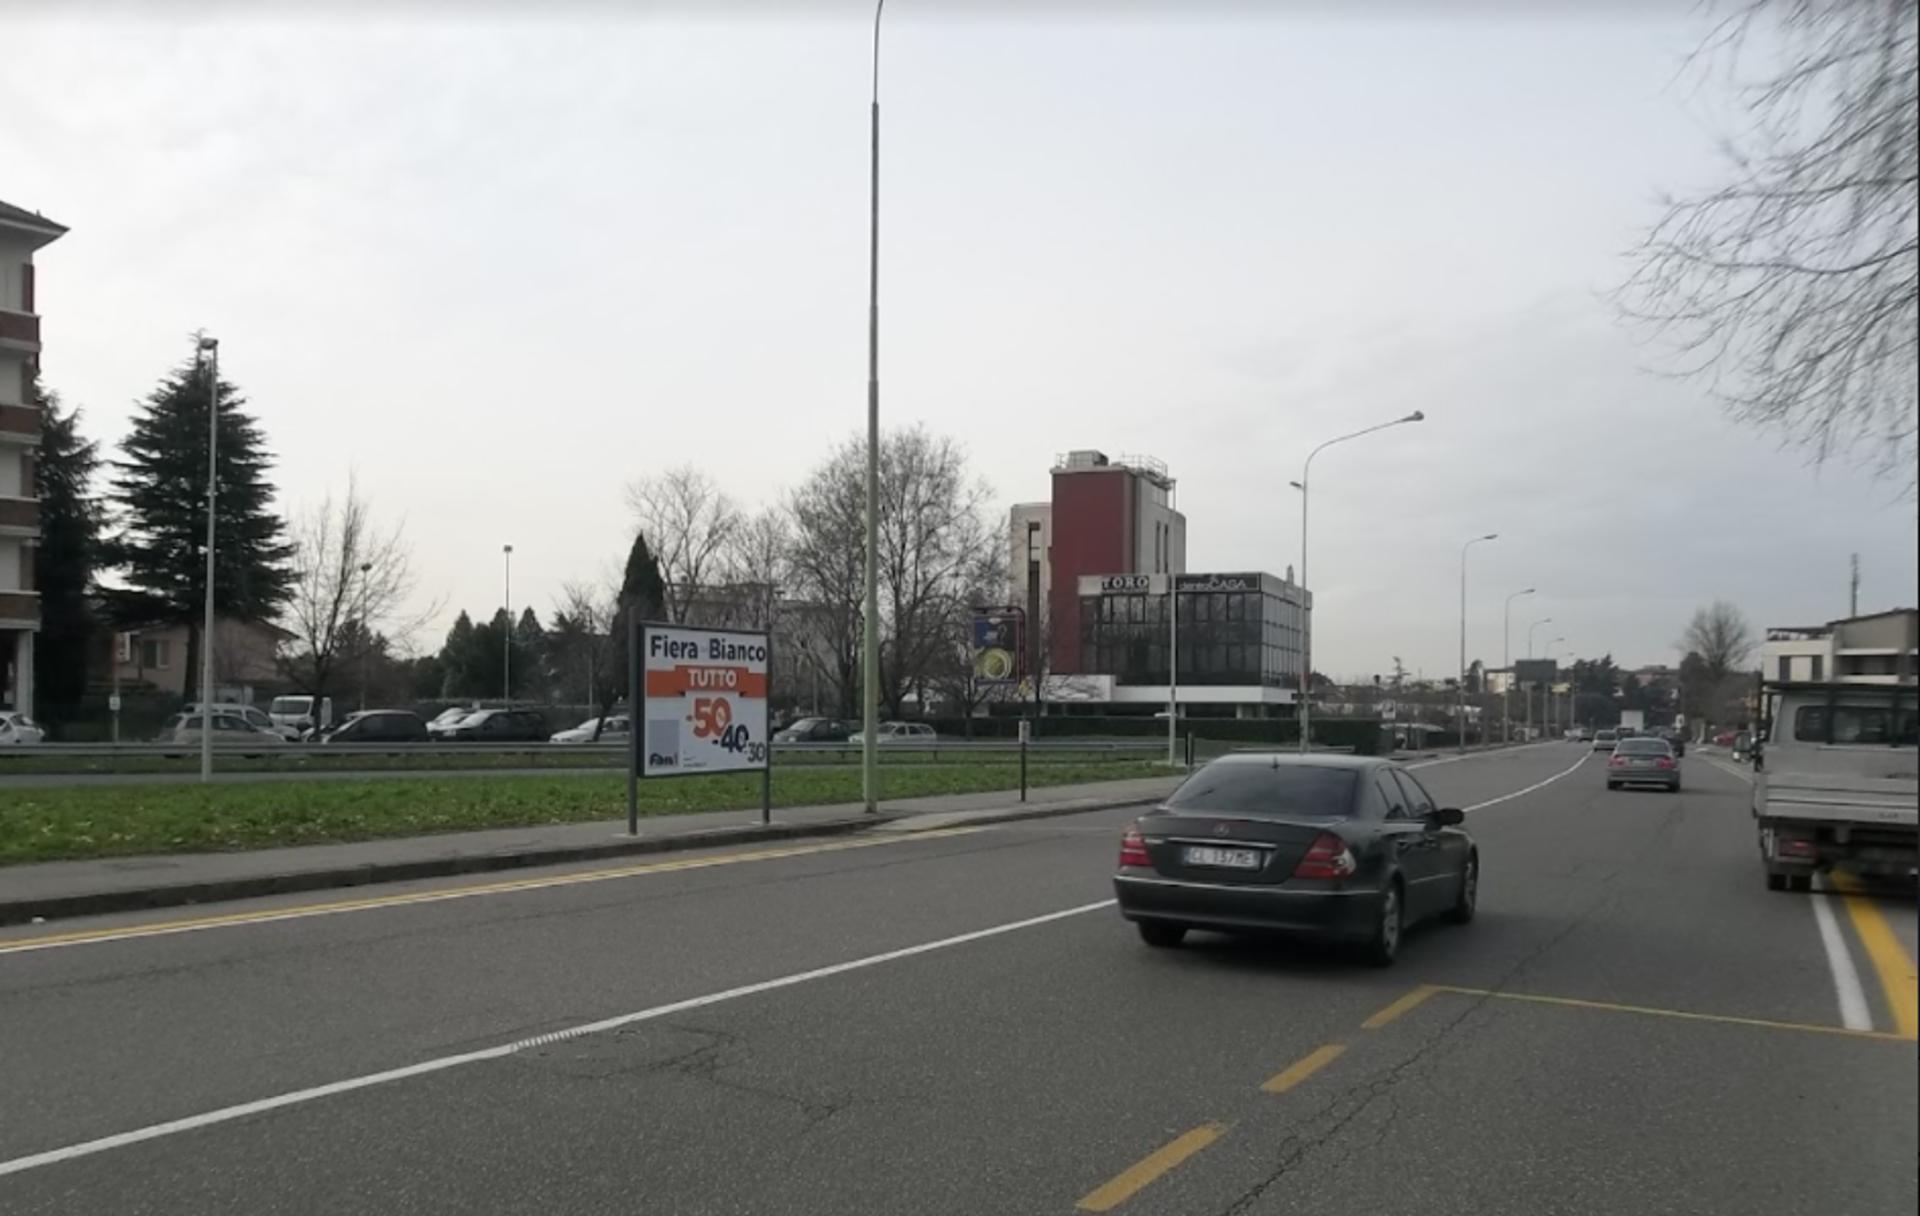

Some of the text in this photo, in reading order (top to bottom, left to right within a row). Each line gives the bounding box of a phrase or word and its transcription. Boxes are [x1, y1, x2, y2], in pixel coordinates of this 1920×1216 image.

[1101, 575, 1149, 589] TORO
[650, 635, 766, 662] Fiera Bianco
[687, 669, 737, 688] TUTTO
